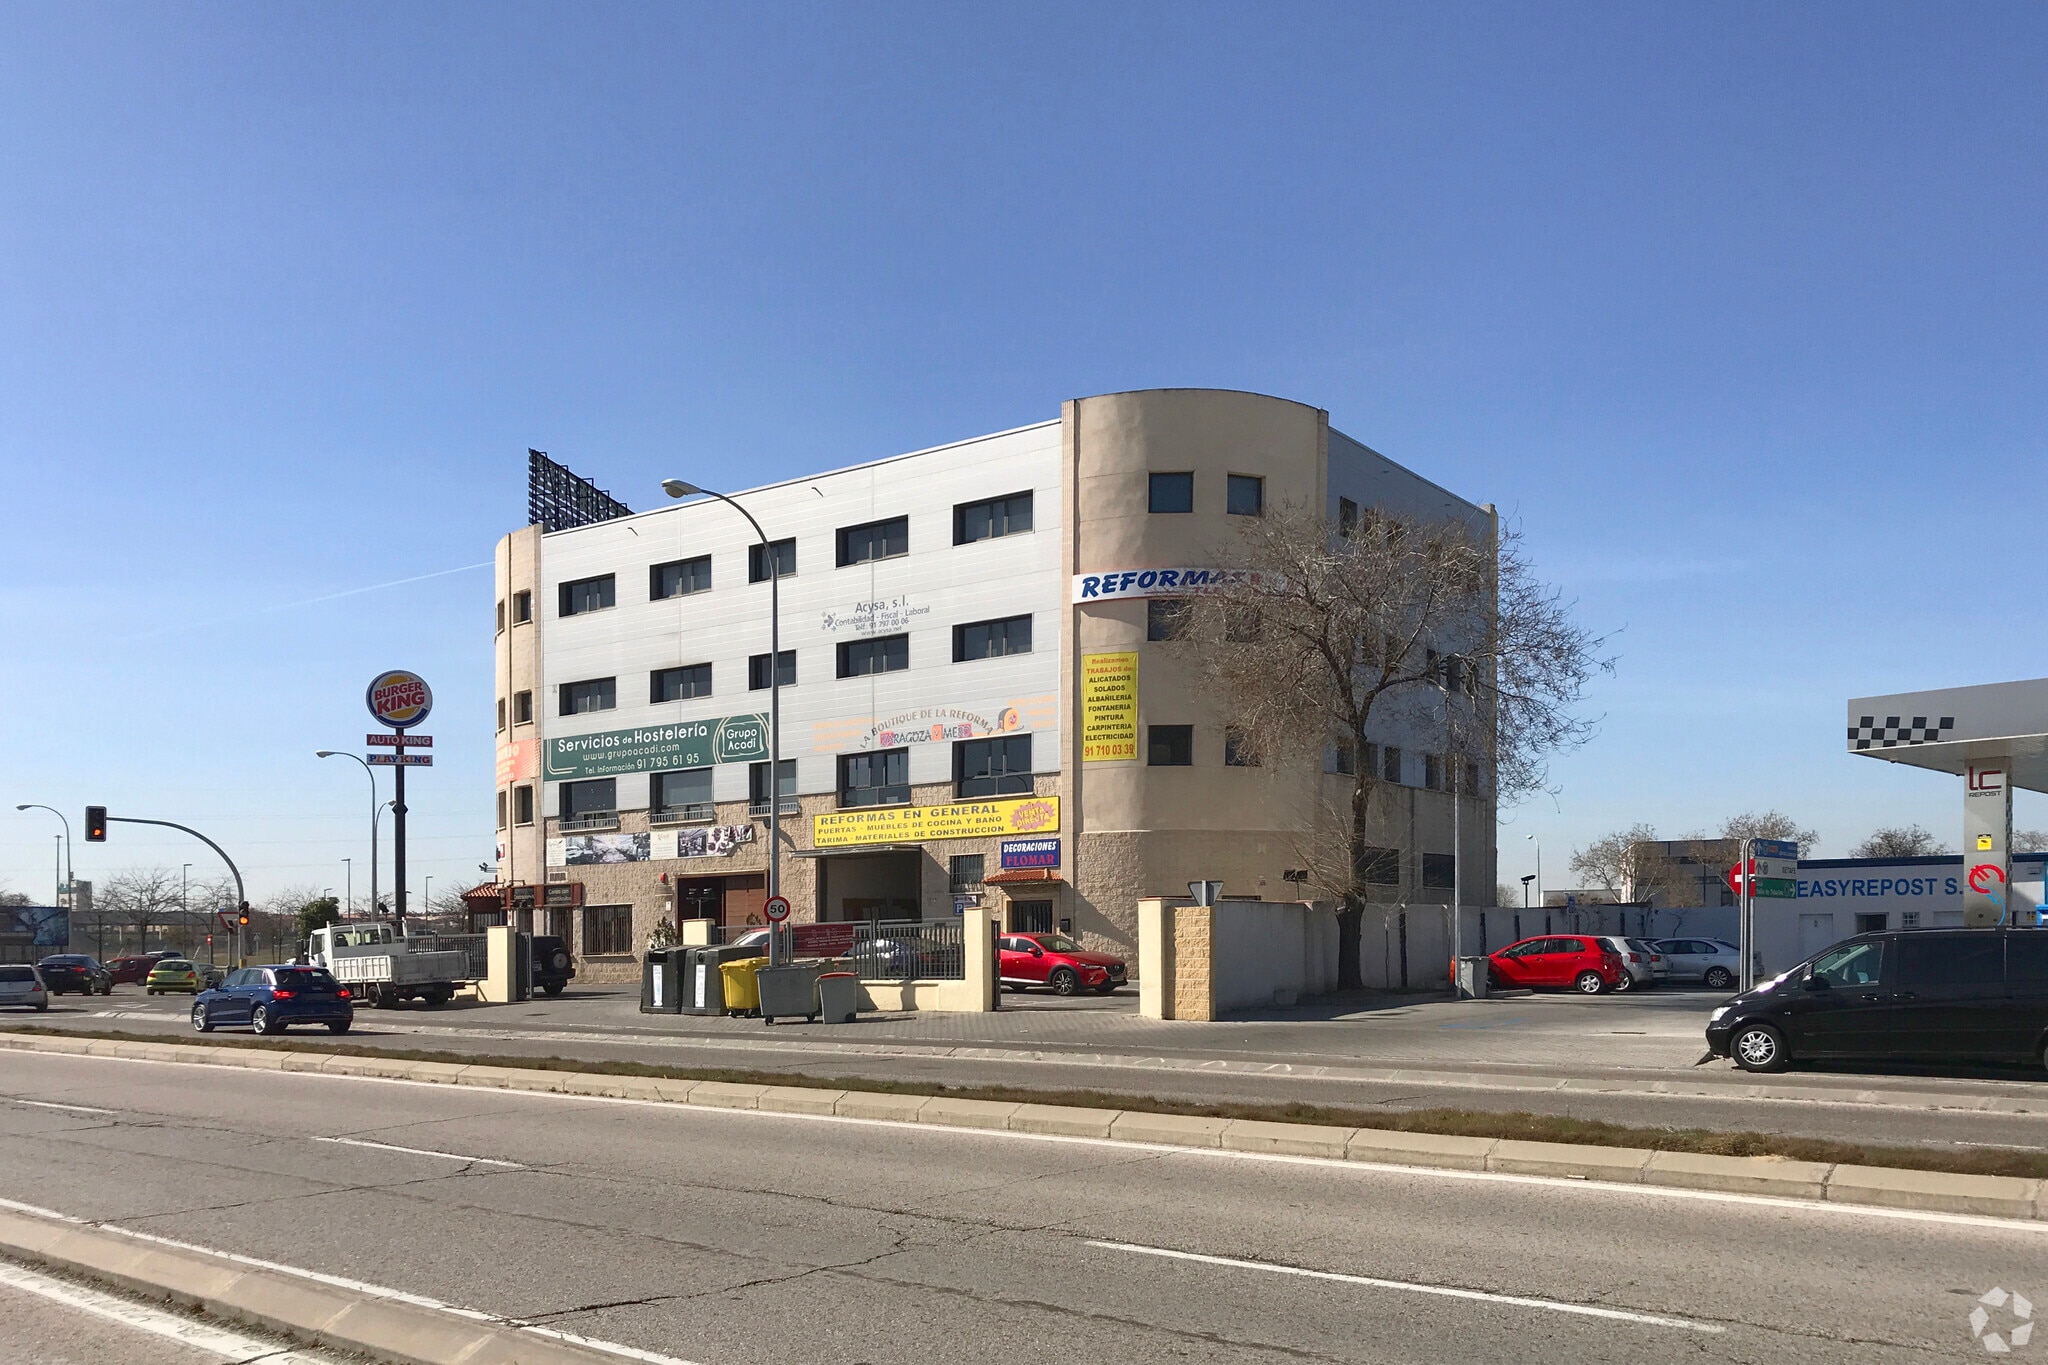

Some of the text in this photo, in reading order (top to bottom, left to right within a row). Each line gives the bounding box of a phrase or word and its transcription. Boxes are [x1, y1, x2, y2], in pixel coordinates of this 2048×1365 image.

[855, 594, 909, 614] Acysa, s.l.
[881, 610, 898, 620] Fiscal
[905, 605, 930, 617] Laboral
[879, 620, 889, 628] 797
[1092, 657, 1128, 665] Realizamos
[1086, 666, 1122, 674] TRABAJOS
[1088, 674, 1131, 684] ALICATADOS
[375, 682, 423, 701] BURGER
[1094, 684, 1126, 692] SOLADOS
[377, 692, 425, 715] KING
[1087, 694, 1132, 703] ALBAÑILERIA
[1088, 704, 1131, 712] FONTANERIA
[870, 711, 918, 736] BOUTIQUE
[920, 709, 933, 719] DE
[935, 708, 947, 718] LA
[949, 709, 994, 735] REFORMA
[1094, 713, 1124, 722] PINTURA
[1086, 722, 1132, 732] CARPINTERIA
[558, 722, 708, 754] Servicios de Hostelería
[726, 727, 758, 740] Grupo
[1085, 732, 1134, 742] ELECTRICIDAD
[369, 735, 431, 746] AUTO KING
[727, 738, 756, 751] Acadi
[582, 743, 680, 762] www.grupoacadi.com
[1084, 746, 1094, 756] 91
[1096, 745, 1110, 756] 710
[1112, 744, 1122, 755] 03
[369, 754, 431, 764] PLAY KING
[636, 758, 647, 769] 91
[650, 756, 668, 768] 795
[672, 754, 684, 766] 61
[687, 753, 700, 764] 95
[1968, 790, 2002, 798] REPOST
[820, 804, 1000, 826] REFORMAS EN GENERAL
[1018, 806, 1047, 818] VENTA
[818, 825, 857, 835] PUERTAS
[866, 822, 908, 832] MUEBLES
[926, 818, 962, 827] COCINA
[976, 814, 1002, 824] BAÑO
[1016, 813, 1050, 826] DIRECTA
[816, 836, 849, 844] TARIMA
[854, 832, 910, 842] MATERIALES
[914, 830, 926, 838] DE
[929, 826, 1005, 836] CONSTRUCCION
[1003, 840, 1057, 854] DECORACIONES
[1006, 854, 1056, 867] FLOMAR
[1797, 877, 1938, 899] EASYREPOST
[770, 904, 786, 914] 50
[956, 903, 964, 914] P
